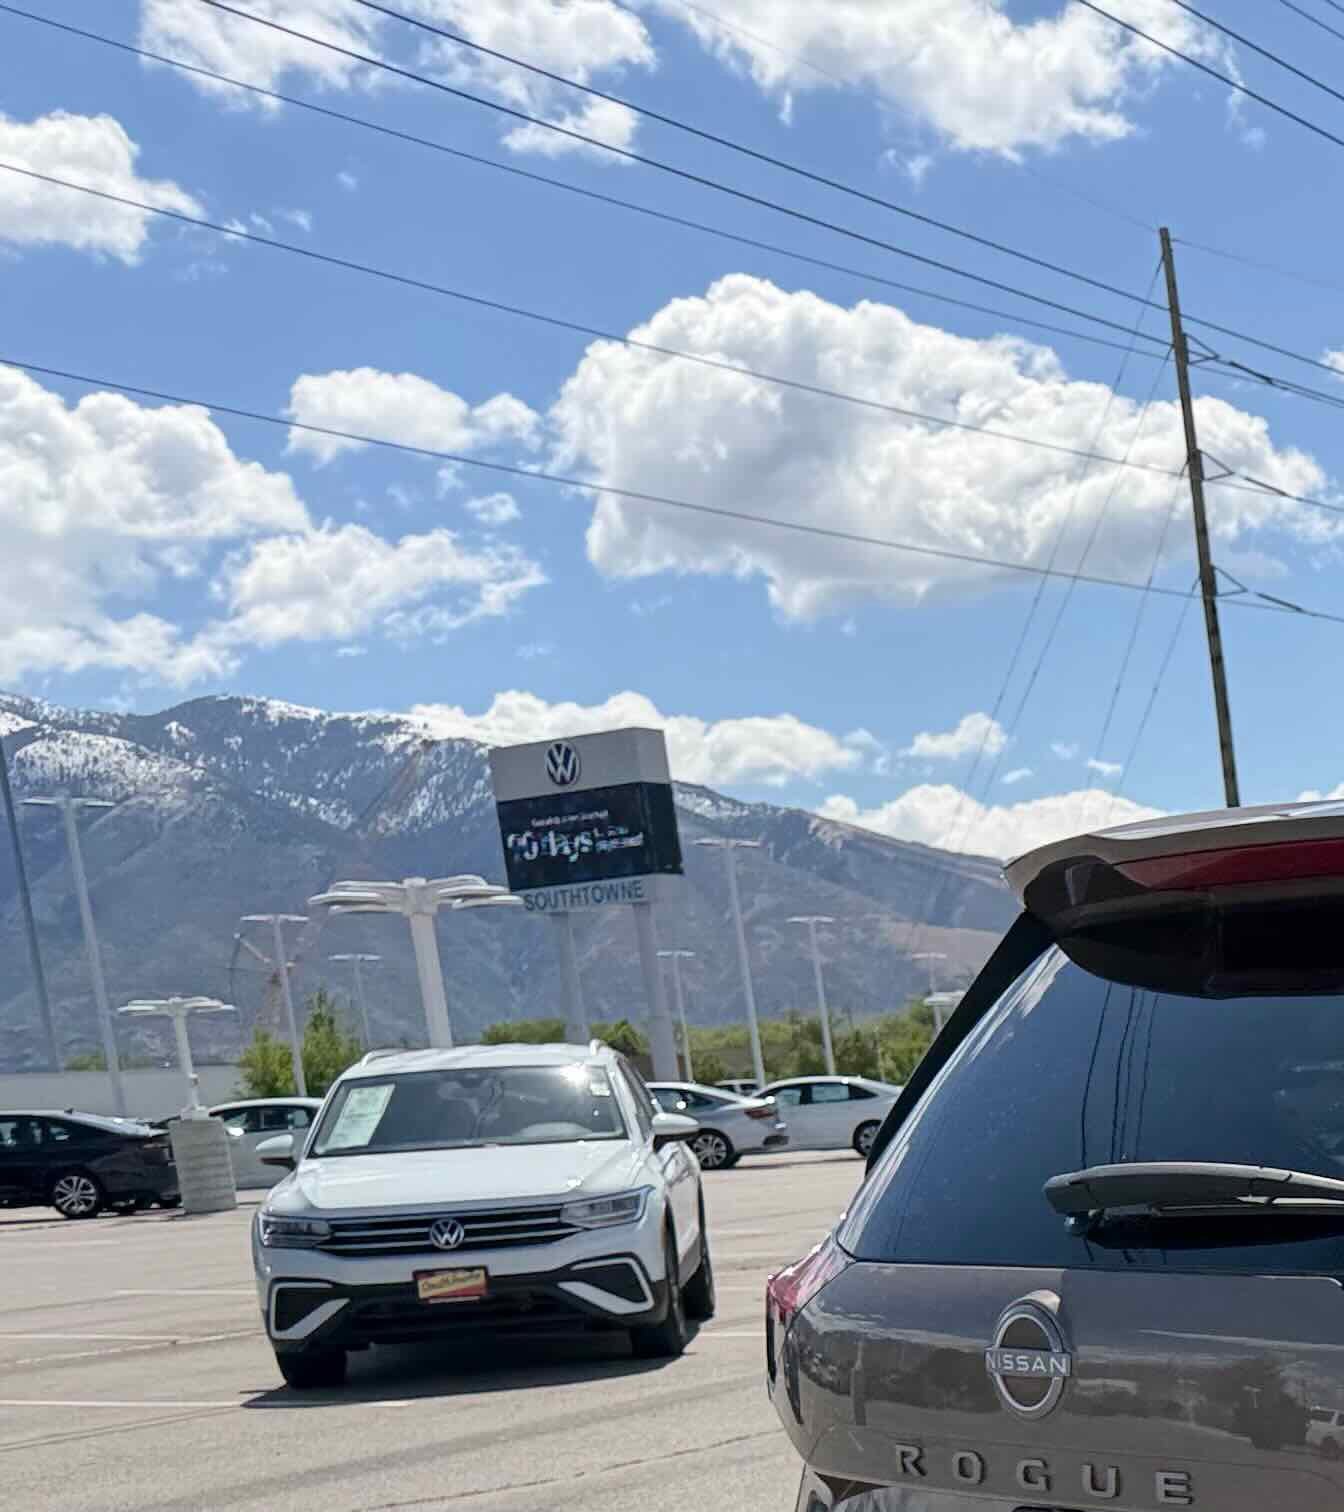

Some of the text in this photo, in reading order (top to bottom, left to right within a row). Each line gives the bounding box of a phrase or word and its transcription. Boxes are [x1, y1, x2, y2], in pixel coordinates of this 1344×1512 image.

[525, 881, 644, 911] SOUTHTOWNE
[985, 1352, 1068, 1375] NISSAN
[895, 1444, 1193, 1505] ROGUE
